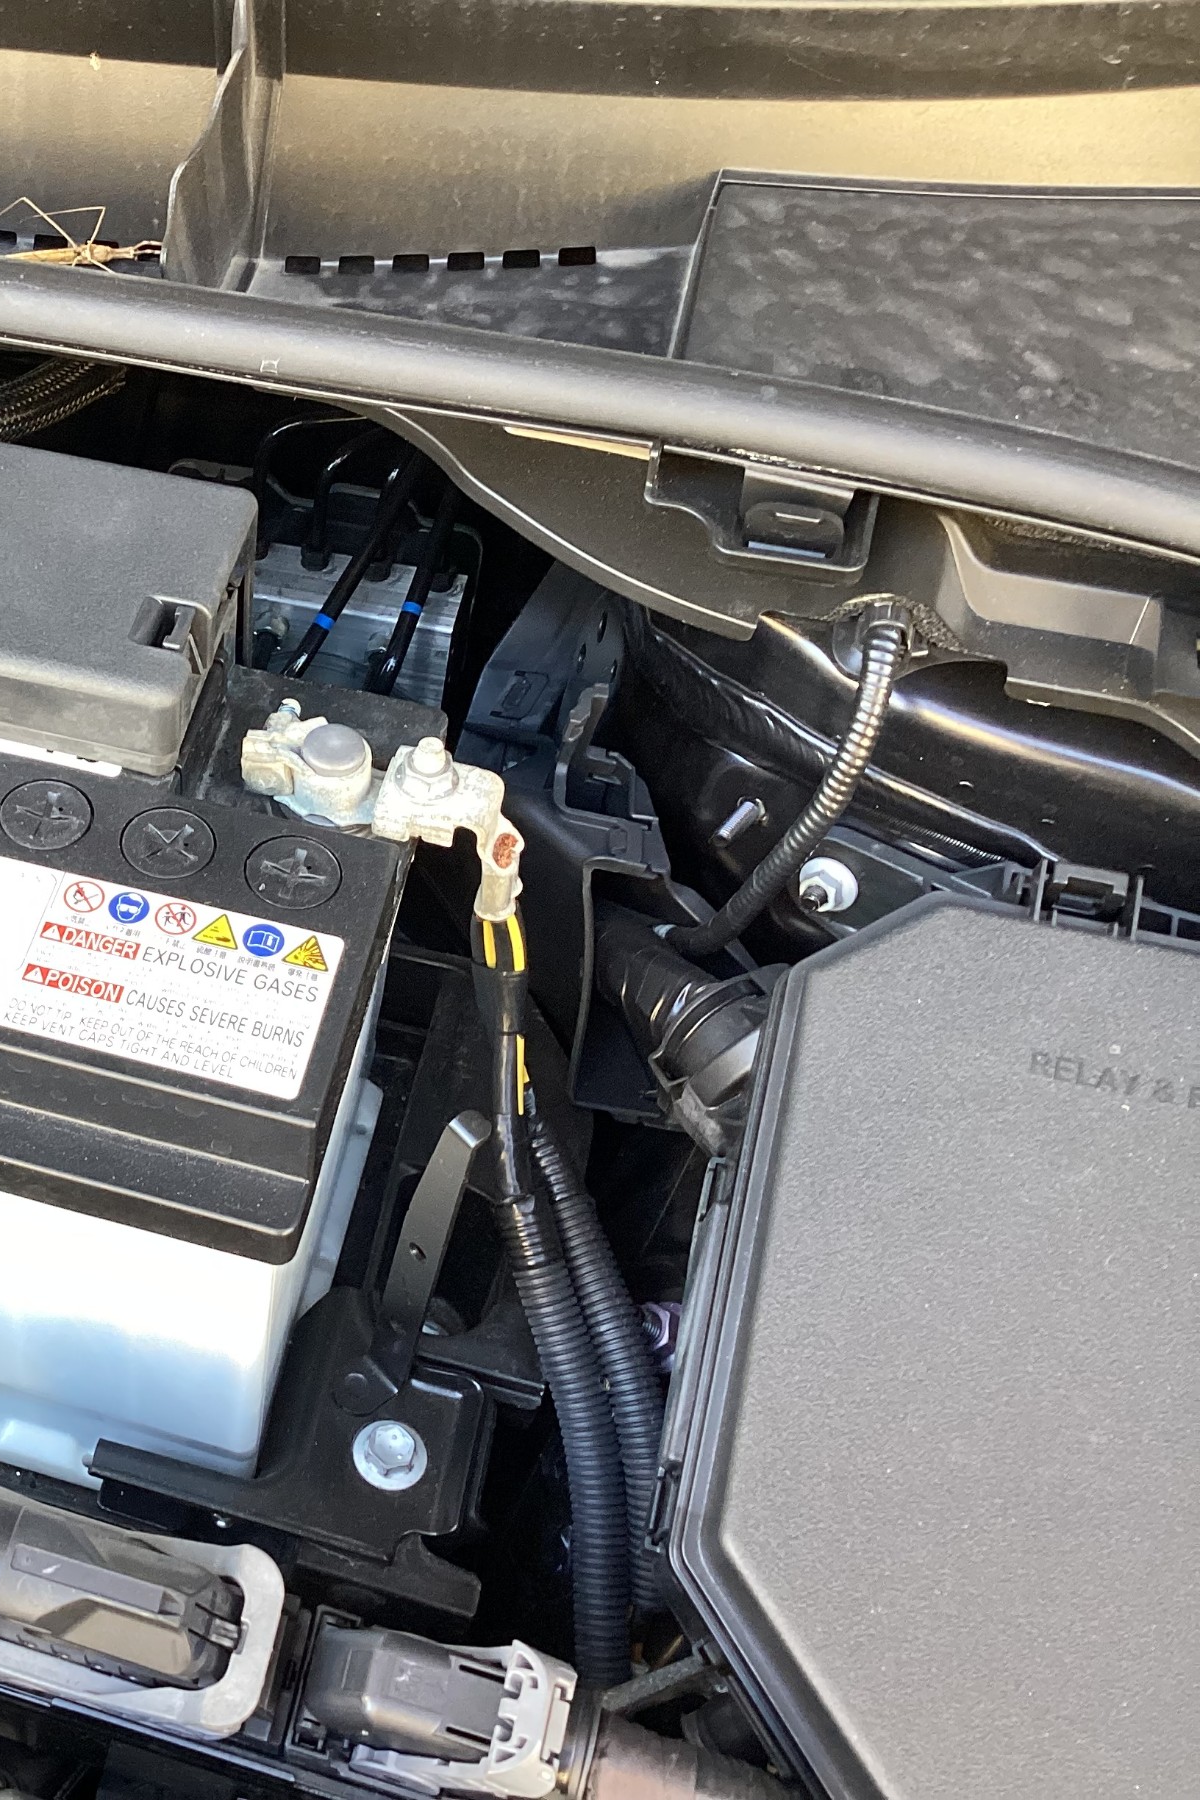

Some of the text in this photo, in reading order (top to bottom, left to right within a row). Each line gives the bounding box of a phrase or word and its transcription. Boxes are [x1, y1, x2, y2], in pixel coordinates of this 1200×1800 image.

[60, 928, 136, 960] DANGER
[142, 946, 248, 985] EXPLOSIVE
[253, 973, 319, 1002] GASES
[3, 1012, 233, 1079] KEEP VENT CAPS TIGHT AND LEVEL
[8, 997, 27, 1011] DO
[30, 1003, 52, 1016] NOT
[79, 1016, 109, 1031] KEEP
[111, 1023, 134, 1037] OUT
[136, 1029, 154, 1042] OF
[157, 1034, 177, 1049] THE
[180, 1041, 218, 1060] REACH
[221, 1051, 237, 1063] OF
[239, 1055, 298, 1080] CHILDREN
[44, 970, 121, 1003] POISON
[126, 989, 186, 1018] CAUSES
[189, 1005, 248, 1034] SEVERE
[251, 1020, 305, 1048] BURNS
[1029, 1052, 1141, 1096] RELAY
